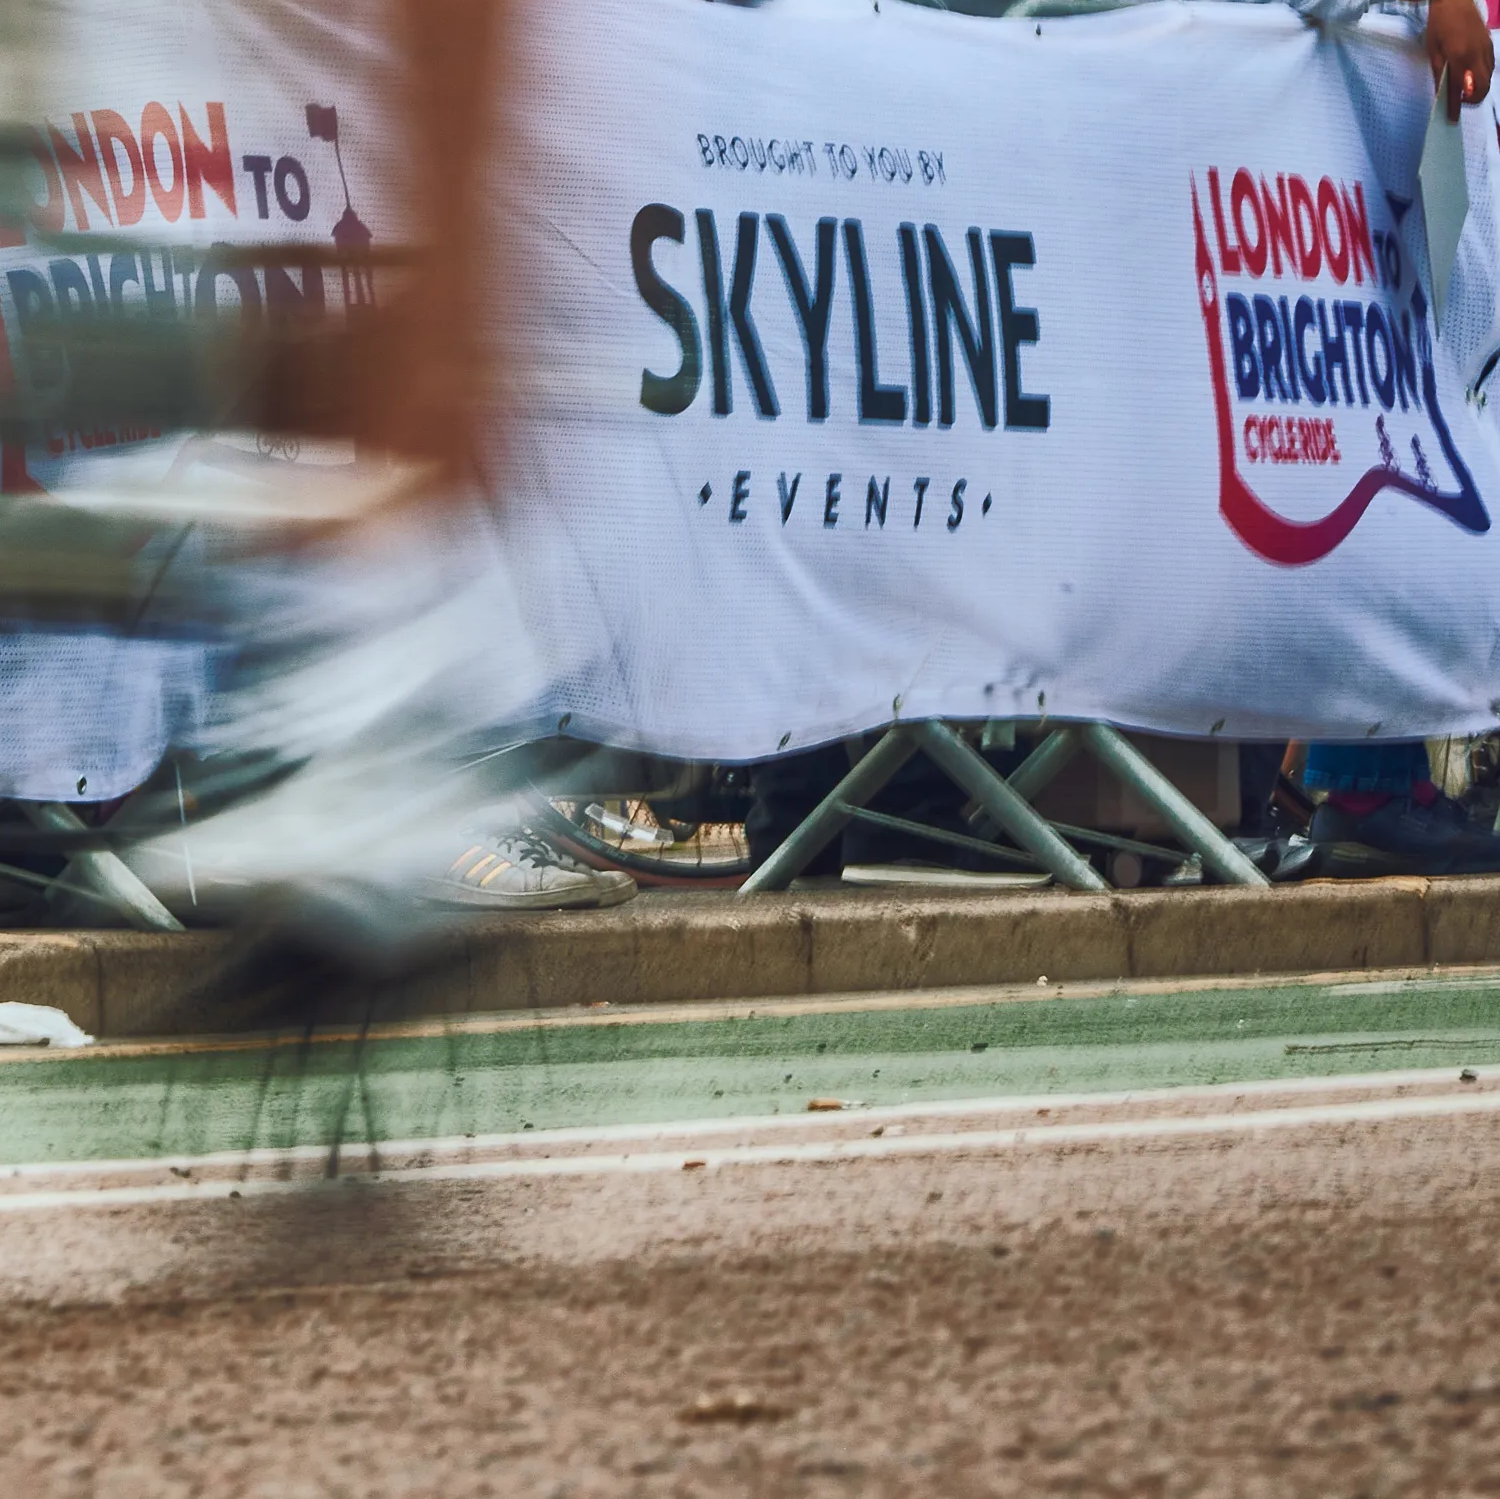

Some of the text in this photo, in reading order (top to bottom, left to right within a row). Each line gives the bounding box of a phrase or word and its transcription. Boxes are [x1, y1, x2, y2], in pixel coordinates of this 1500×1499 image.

[243, 155, 311, 222] TO
[697, 133, 948, 187] BROUGHT TO YOU BY
[1208, 165, 1401, 292] LONDON TO
[629, 202, 1051, 433] SKYLINE
[1225, 291, 1422, 413] BRIGHTON
[728, 469, 970, 532] EVENTS
